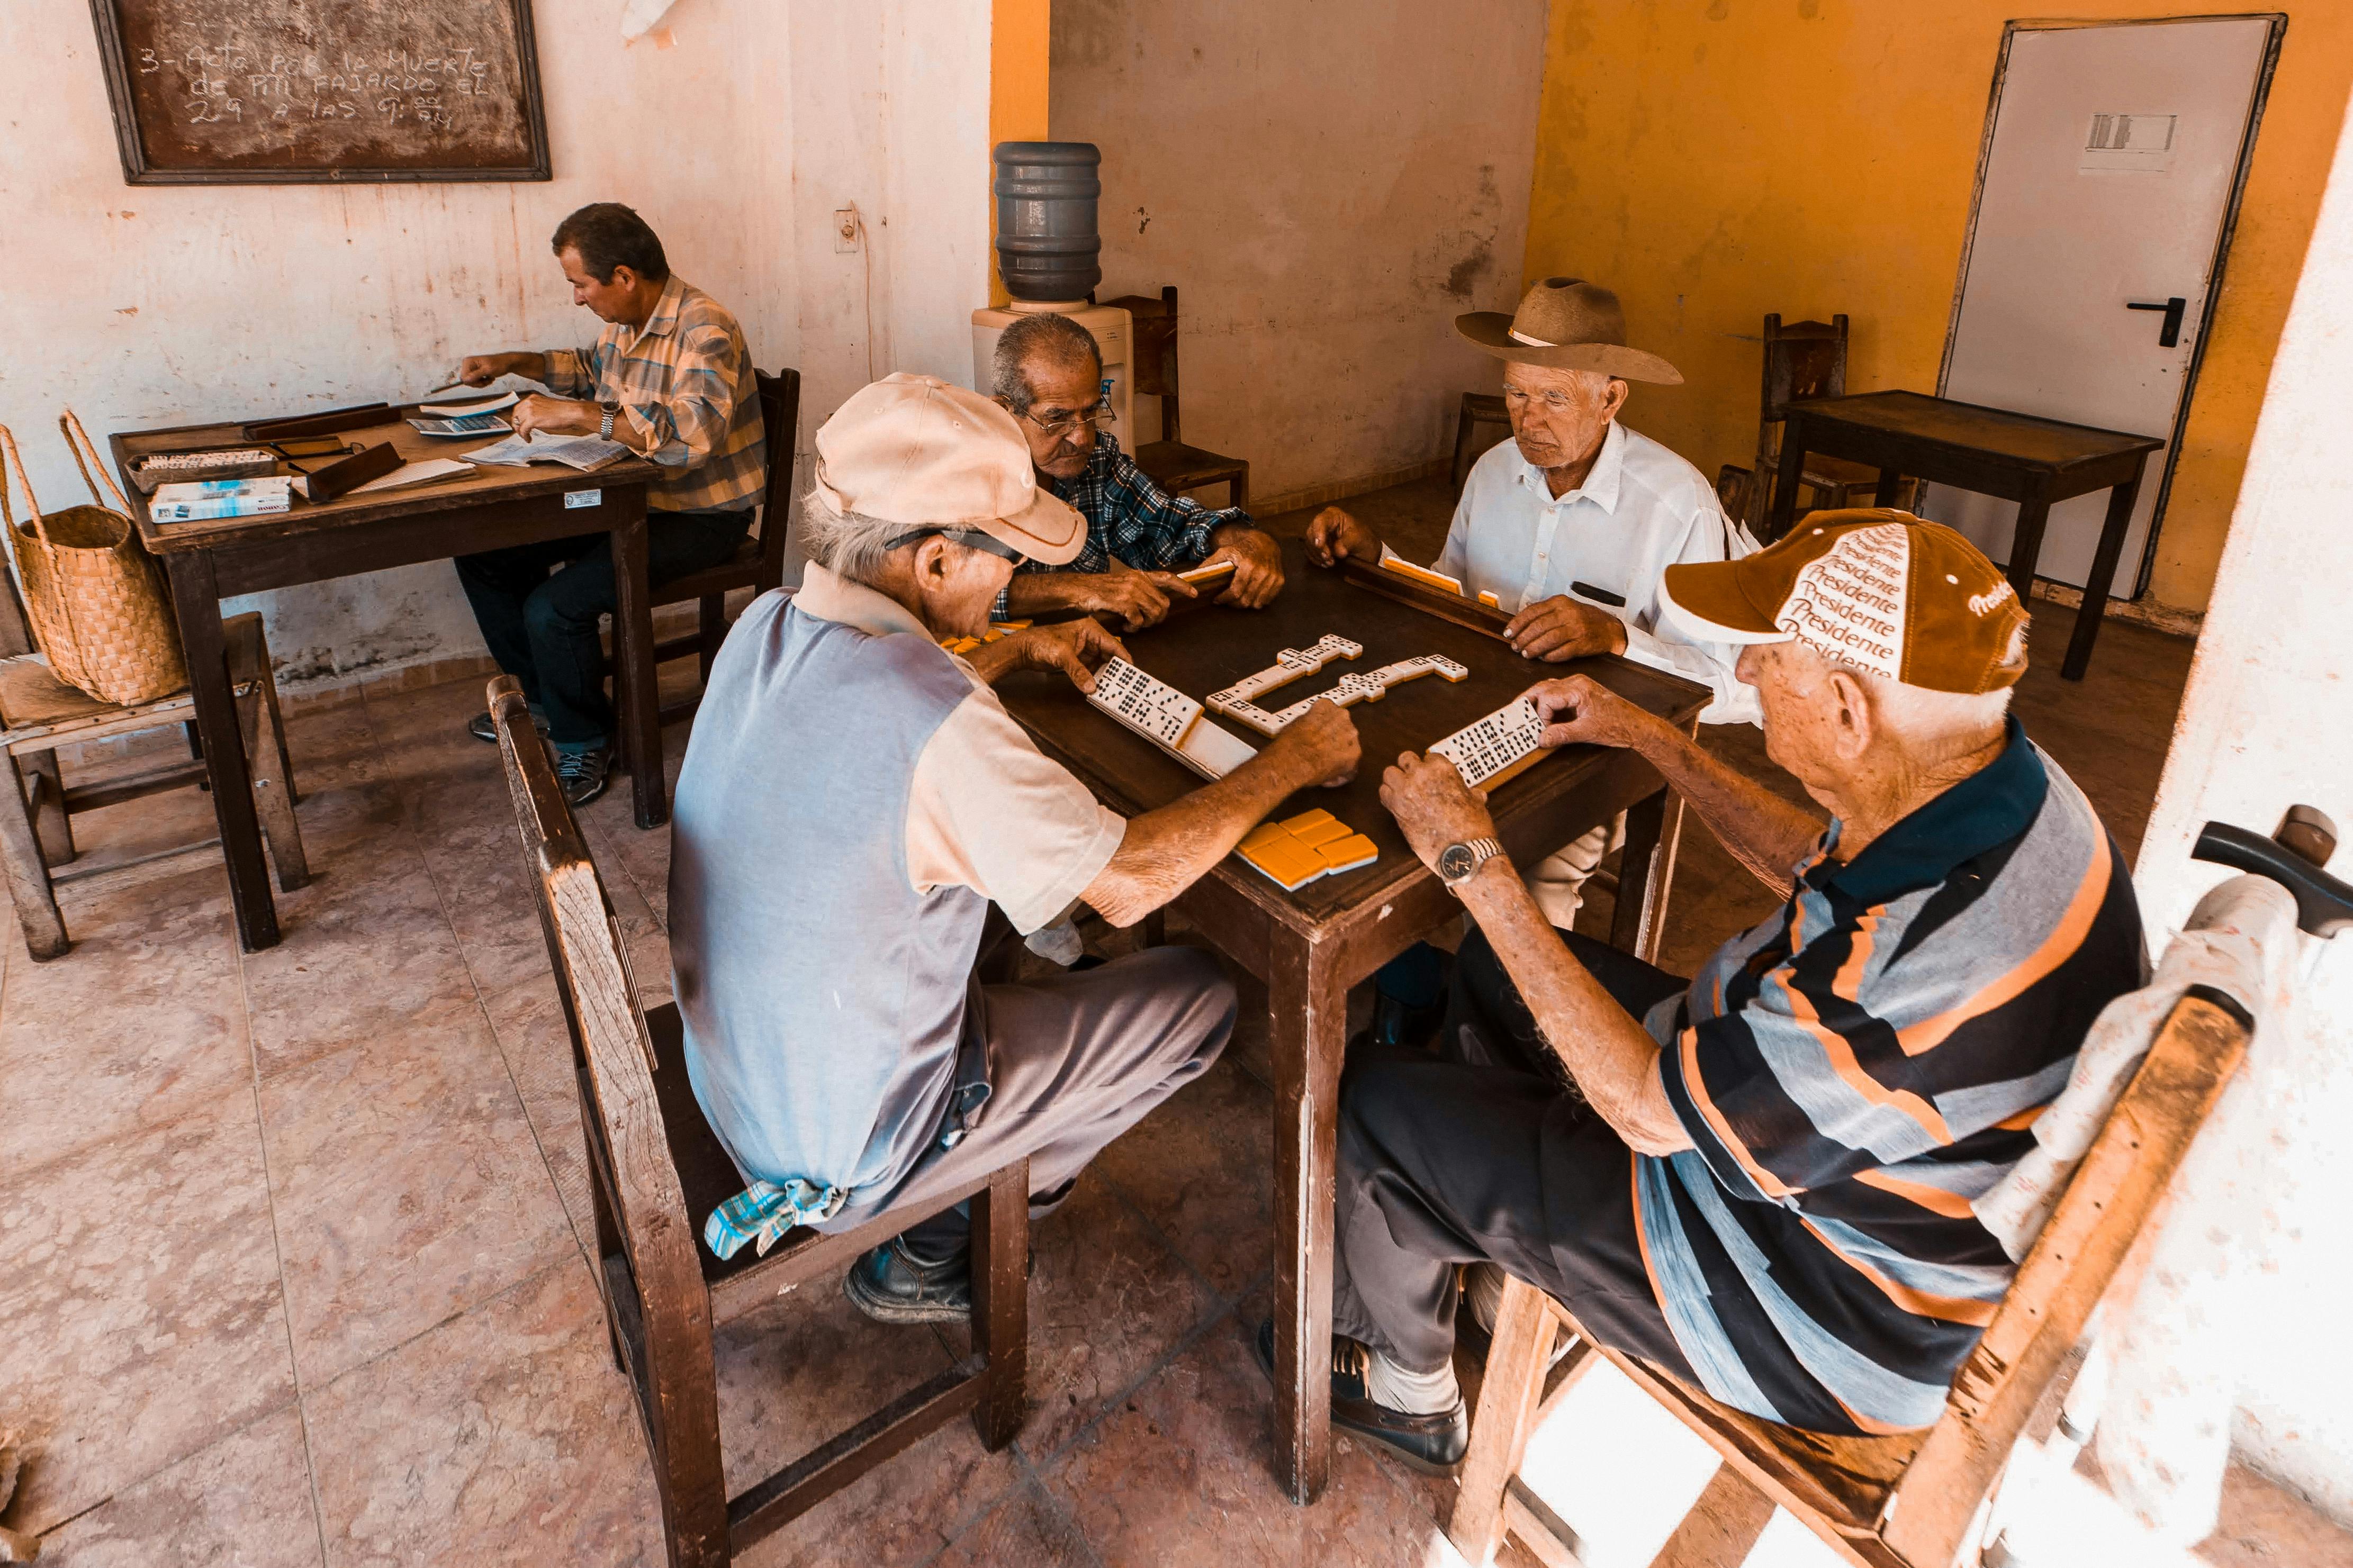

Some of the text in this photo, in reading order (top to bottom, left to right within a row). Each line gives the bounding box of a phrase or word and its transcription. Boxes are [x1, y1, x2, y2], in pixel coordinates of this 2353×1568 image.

[185, 99, 242, 124] 29
[1800, 580, 1896, 637] Presidente
[1807, 564, 1899, 614] Presidente
[1790, 598, 1895, 659] Presidente
